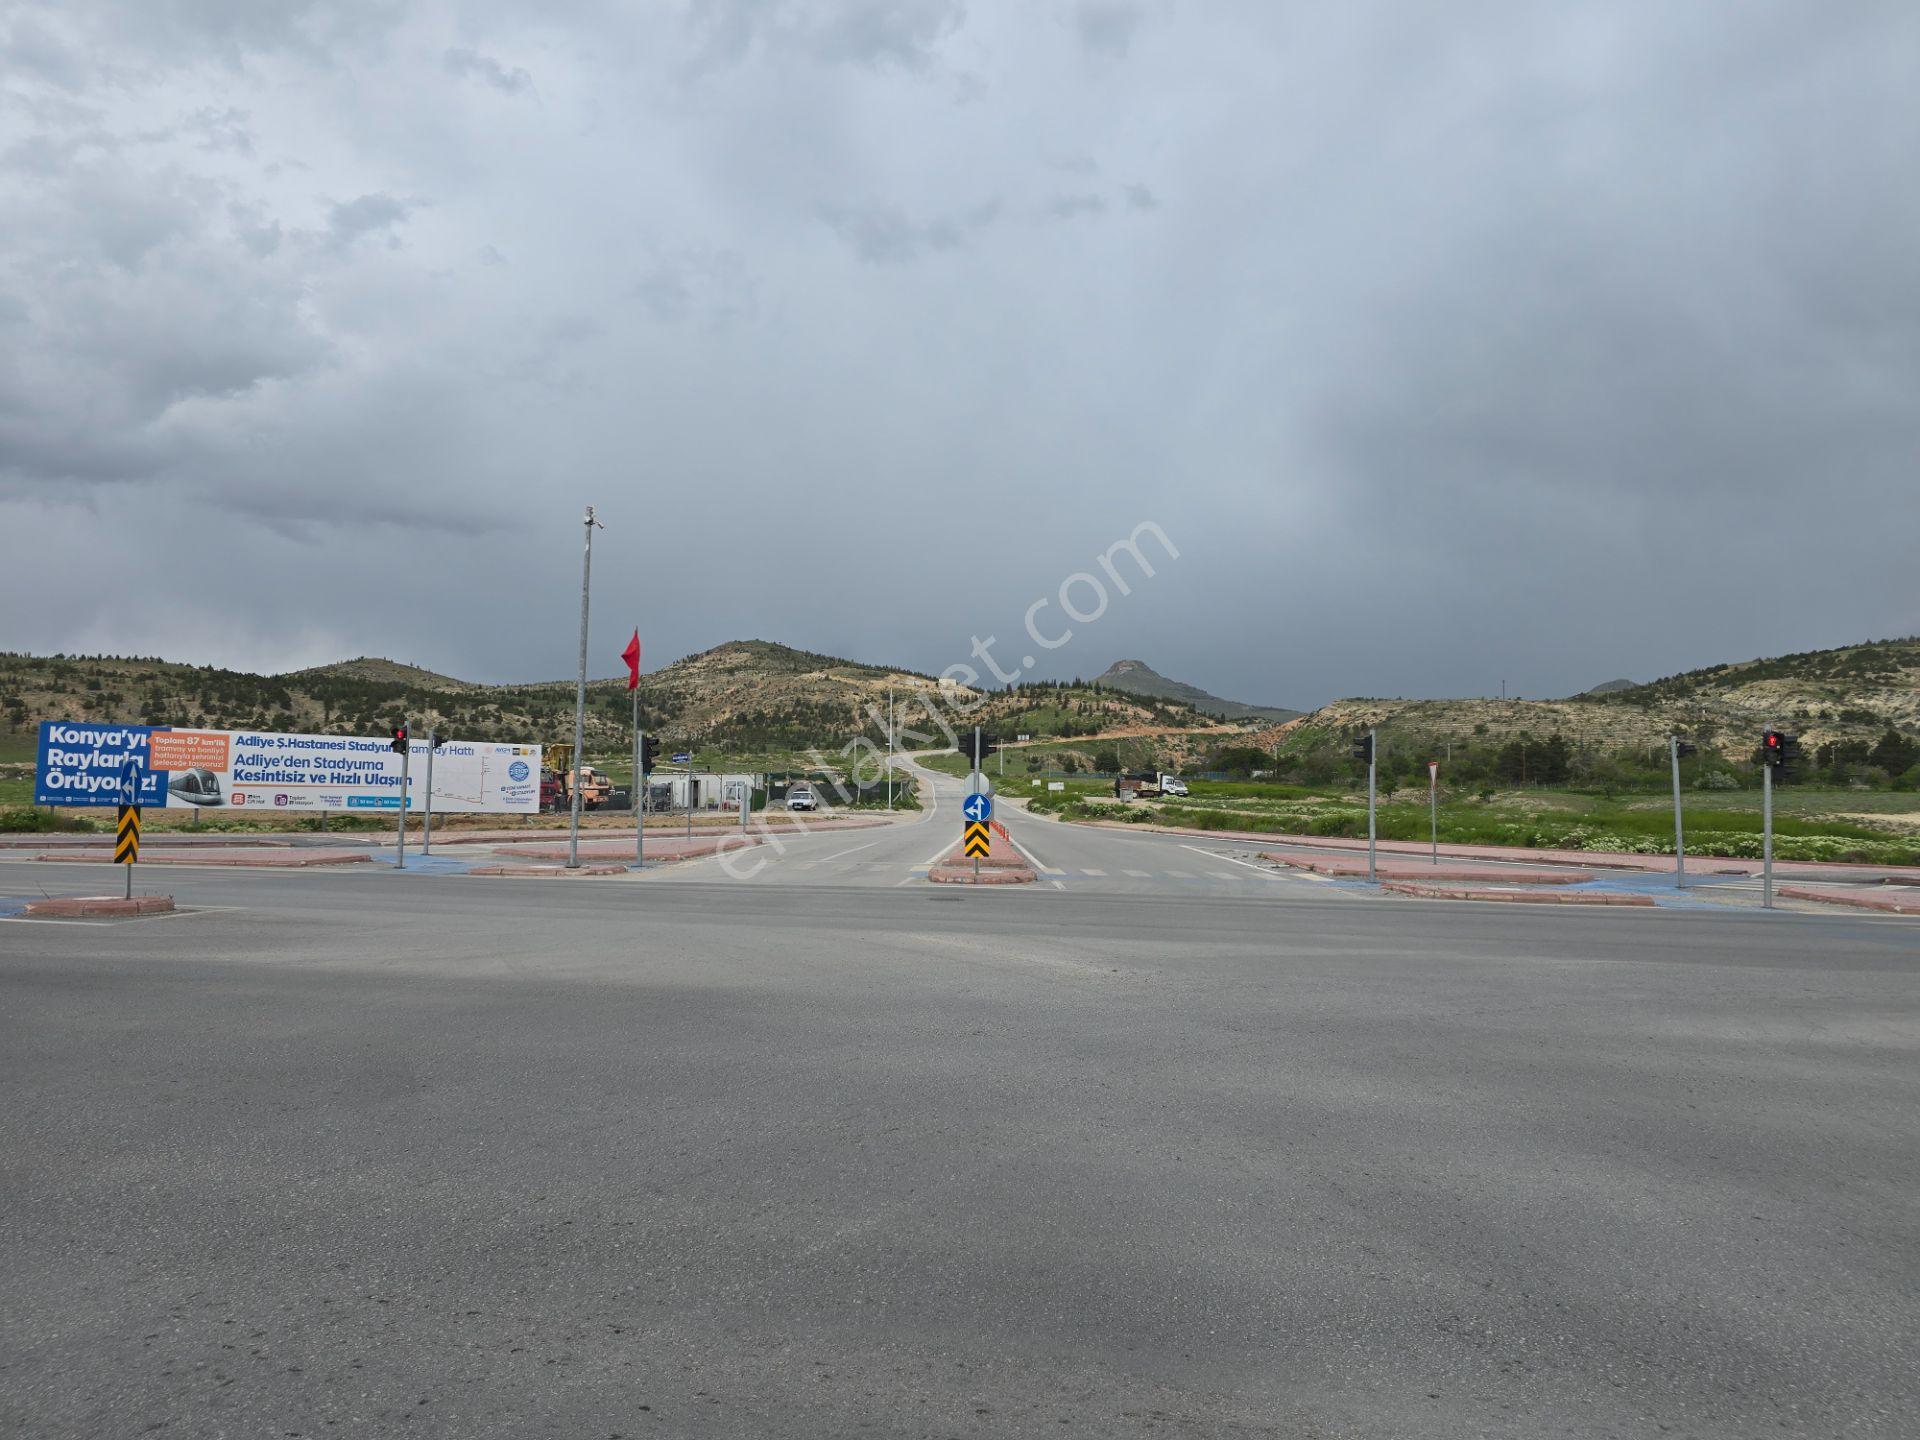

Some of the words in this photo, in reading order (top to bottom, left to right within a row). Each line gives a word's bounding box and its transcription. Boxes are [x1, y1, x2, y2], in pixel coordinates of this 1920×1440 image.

[49, 726, 147, 749] Konya'yı
[155, 736, 185, 745] Toplam
[187, 737, 199, 745] 87
[235, 735, 274, 749] Adliye
[277, 738, 345, 751] Ş.Hastanesi
[449, 745, 475, 756] Hattı
[234, 753, 310, 769] Adliye'den
[313, 756, 384, 772] Stadyuma
[233, 768, 305, 783] Kesintisiz
[309, 772, 327, 784] ve
[330, 772, 361, 785] Hızlı
